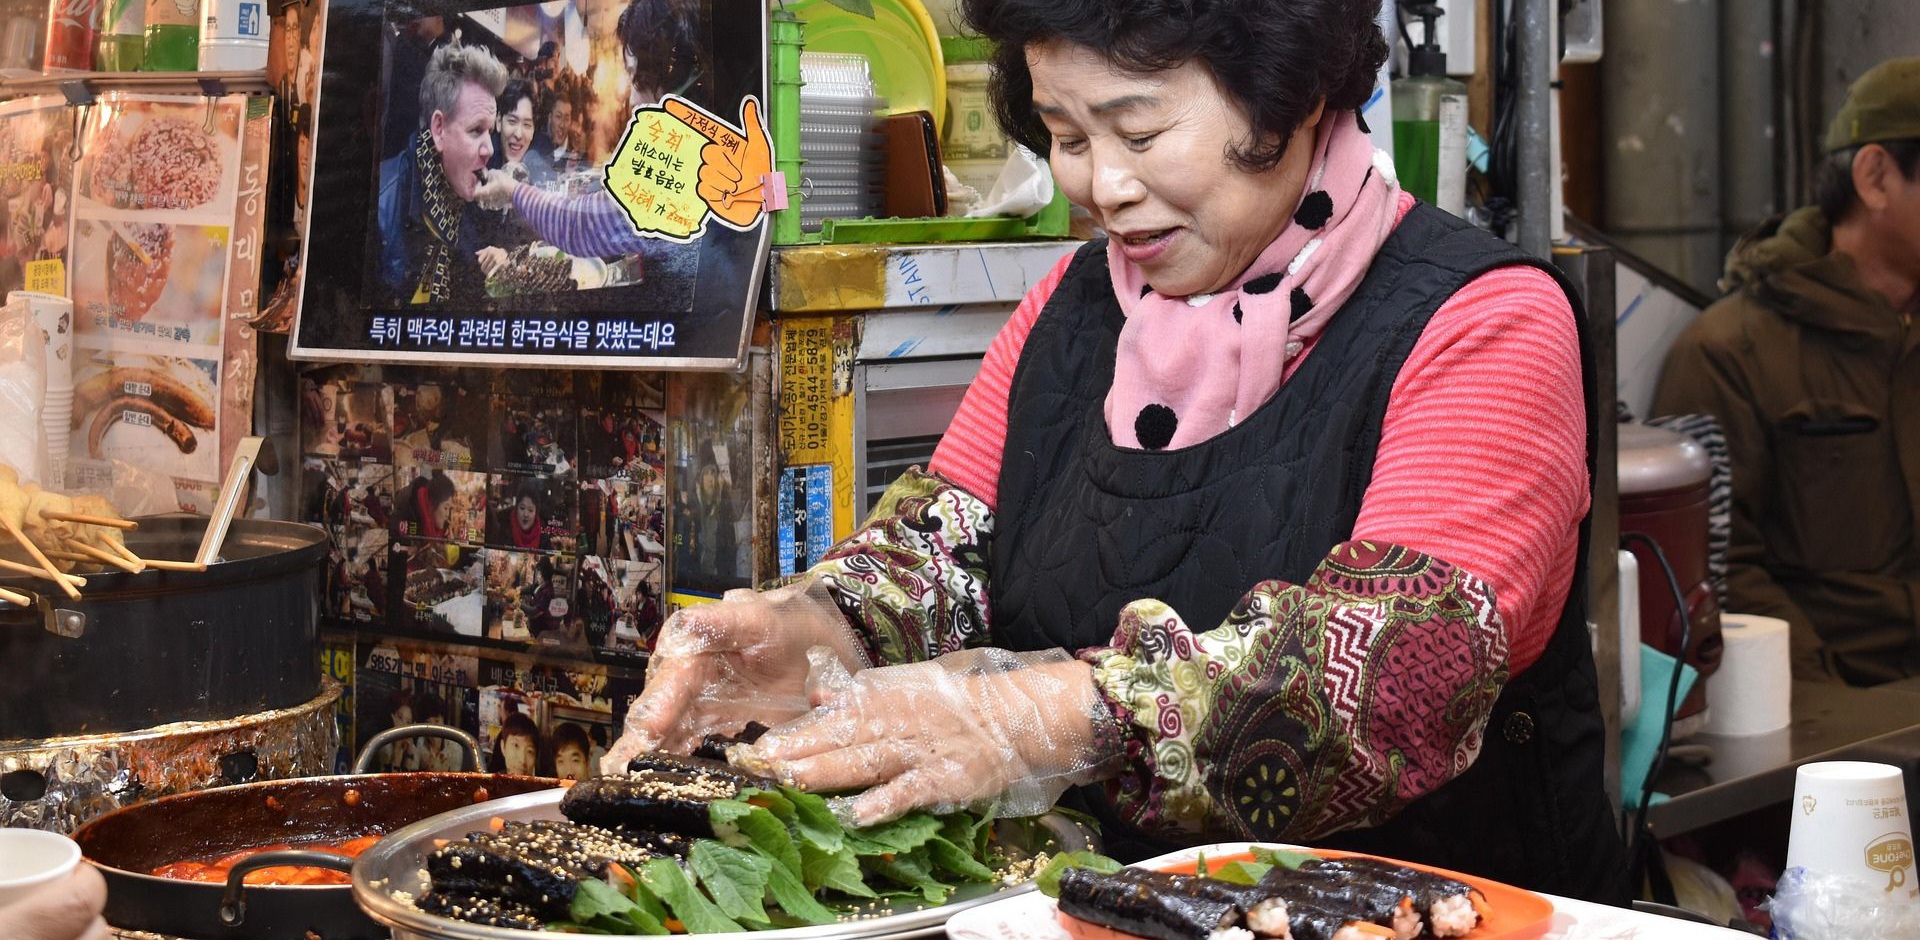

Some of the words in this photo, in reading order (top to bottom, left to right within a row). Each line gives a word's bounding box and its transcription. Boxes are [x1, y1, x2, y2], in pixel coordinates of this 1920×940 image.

[683, 111, 719, 138] 가정식
[720, 132, 740, 155] 식혜
[634, 139, 685, 172] 해소에는
[631, 158, 686, 194] 발효음료인
[370, 317, 402, 344] 특히
[407, 318, 455, 346] 맥주와
[458, 320, 506, 347] 관련된
[511, 319, 591, 349] 한국음식을
[596, 321, 676, 350] 맛봤는데요
[784, 330, 797, 376] 전문업체
[807, 329, 818, 449] 010-4544-5879
[784, 381, 797, 450] 도시가스공사
[491, 667, 515, 687] 배우
